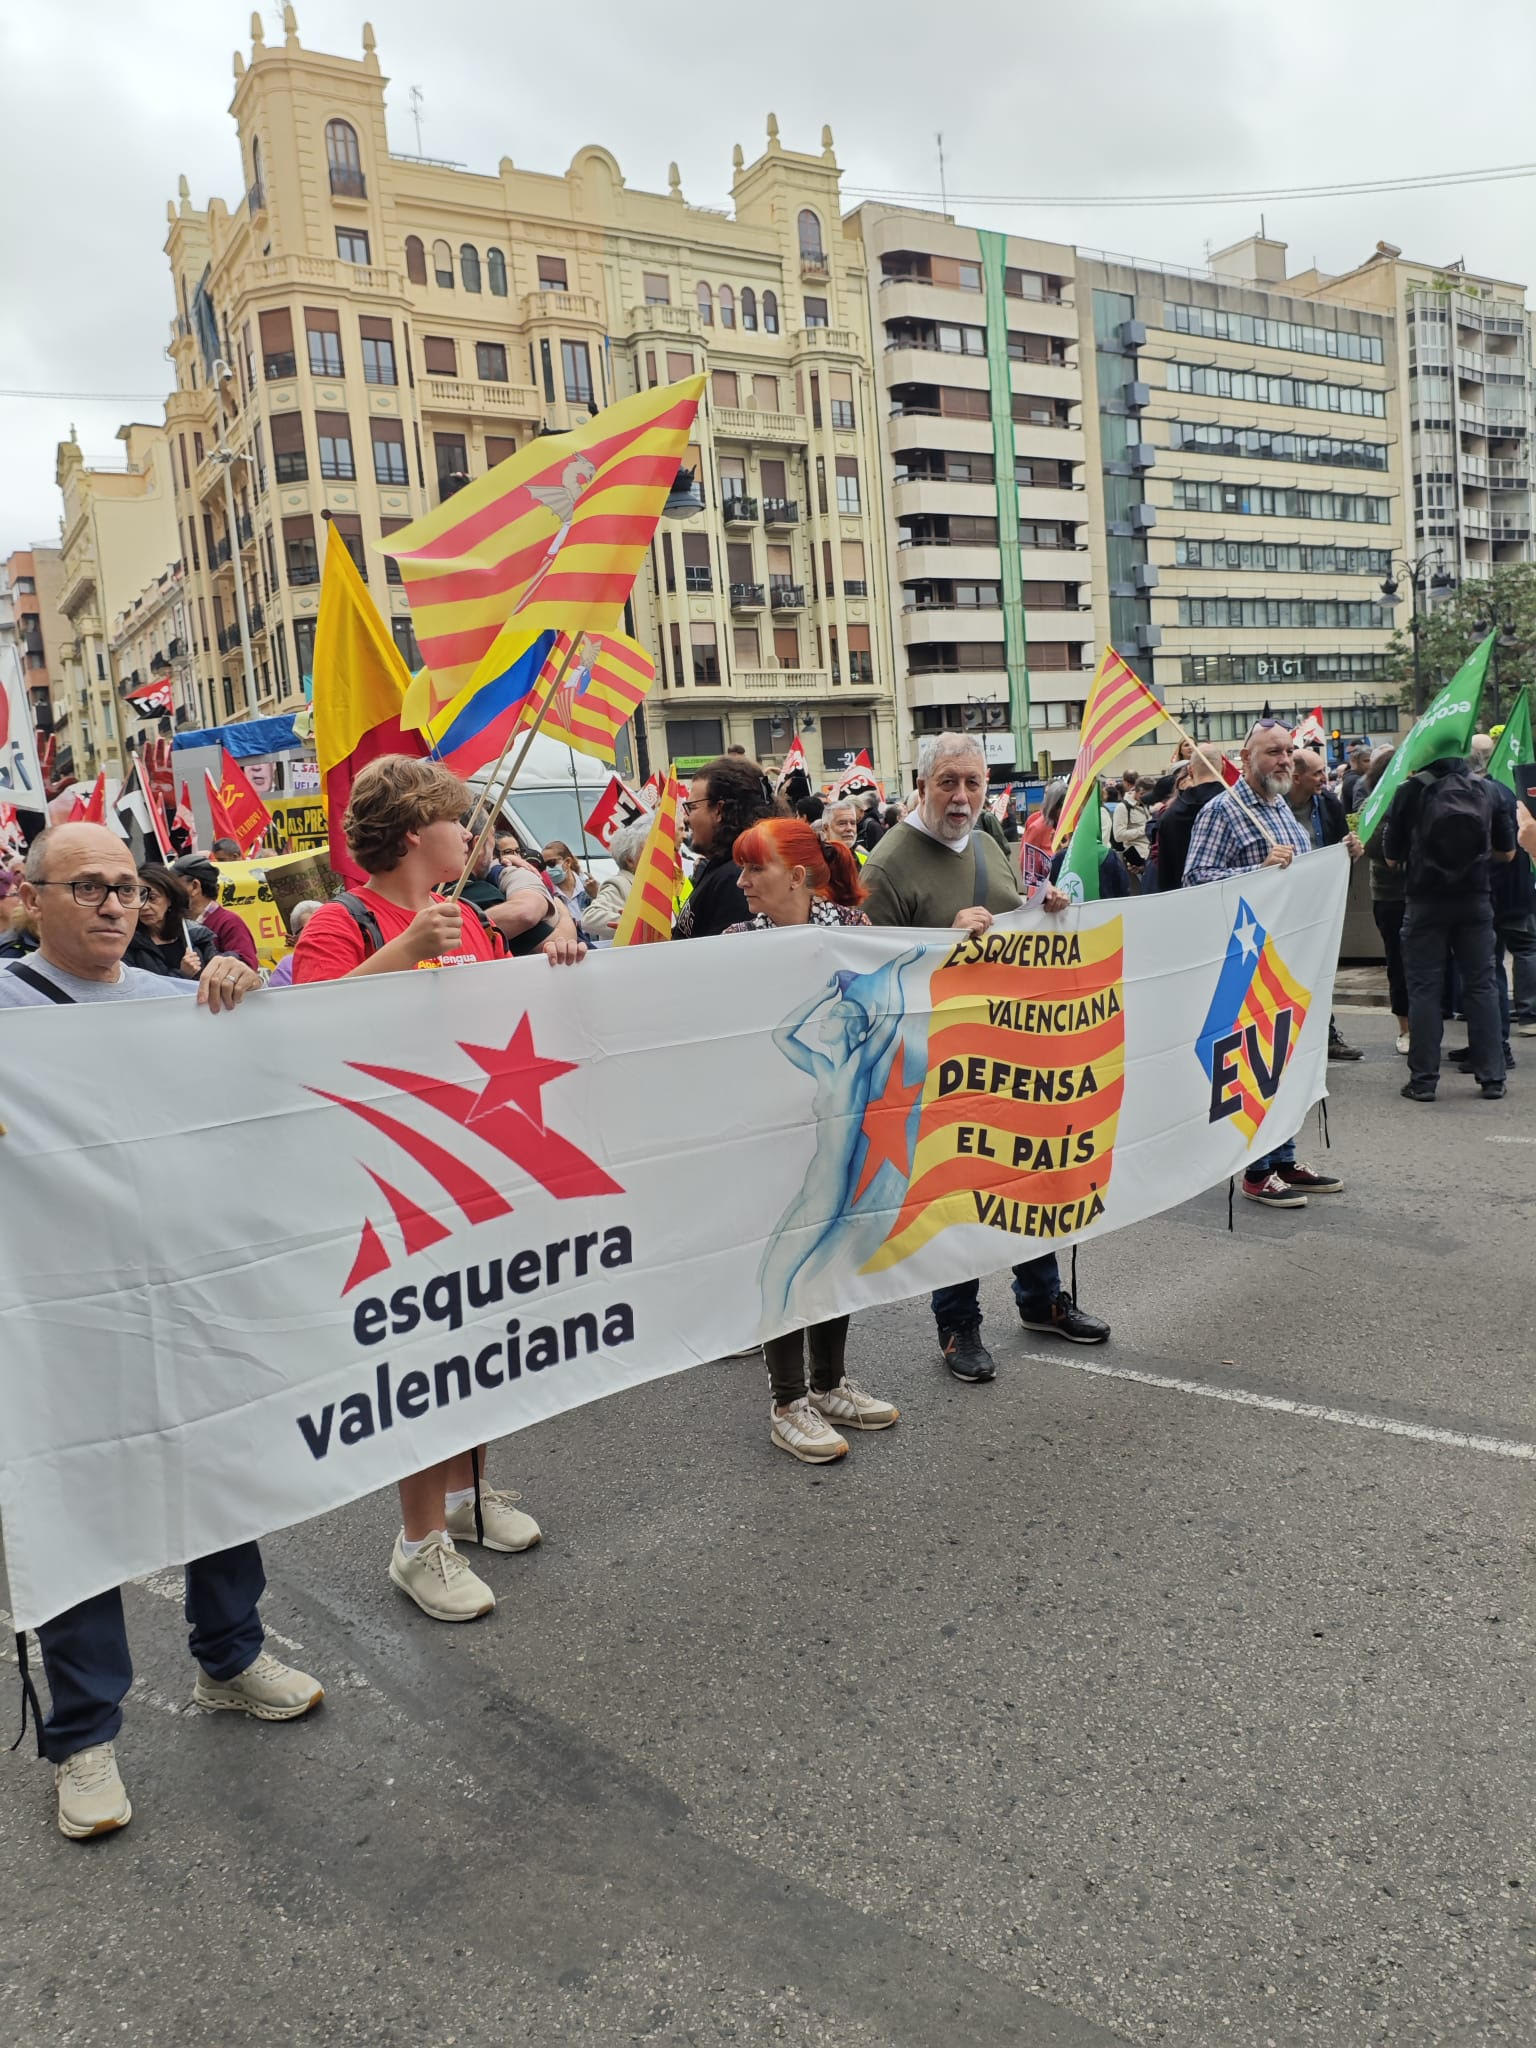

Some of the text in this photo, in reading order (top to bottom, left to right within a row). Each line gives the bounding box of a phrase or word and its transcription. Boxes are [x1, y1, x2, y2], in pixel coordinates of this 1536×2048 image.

[1257, 660, 1302, 675] DIGI
[942, 934, 1082, 968] ESQUERRA
[986, 988, 1120, 1033] VALENCIANA
[939, 1057, 1098, 1102] DEFENSA
[1209, 1007, 1293, 1124] EV
[957, 1124, 1095, 1170] EL PAÍS
[972, 1182, 1106, 1237] VALENCIÀ
[353, 1225, 633, 1346] esquerra
[296, 1302, 635, 1461] valenciana
